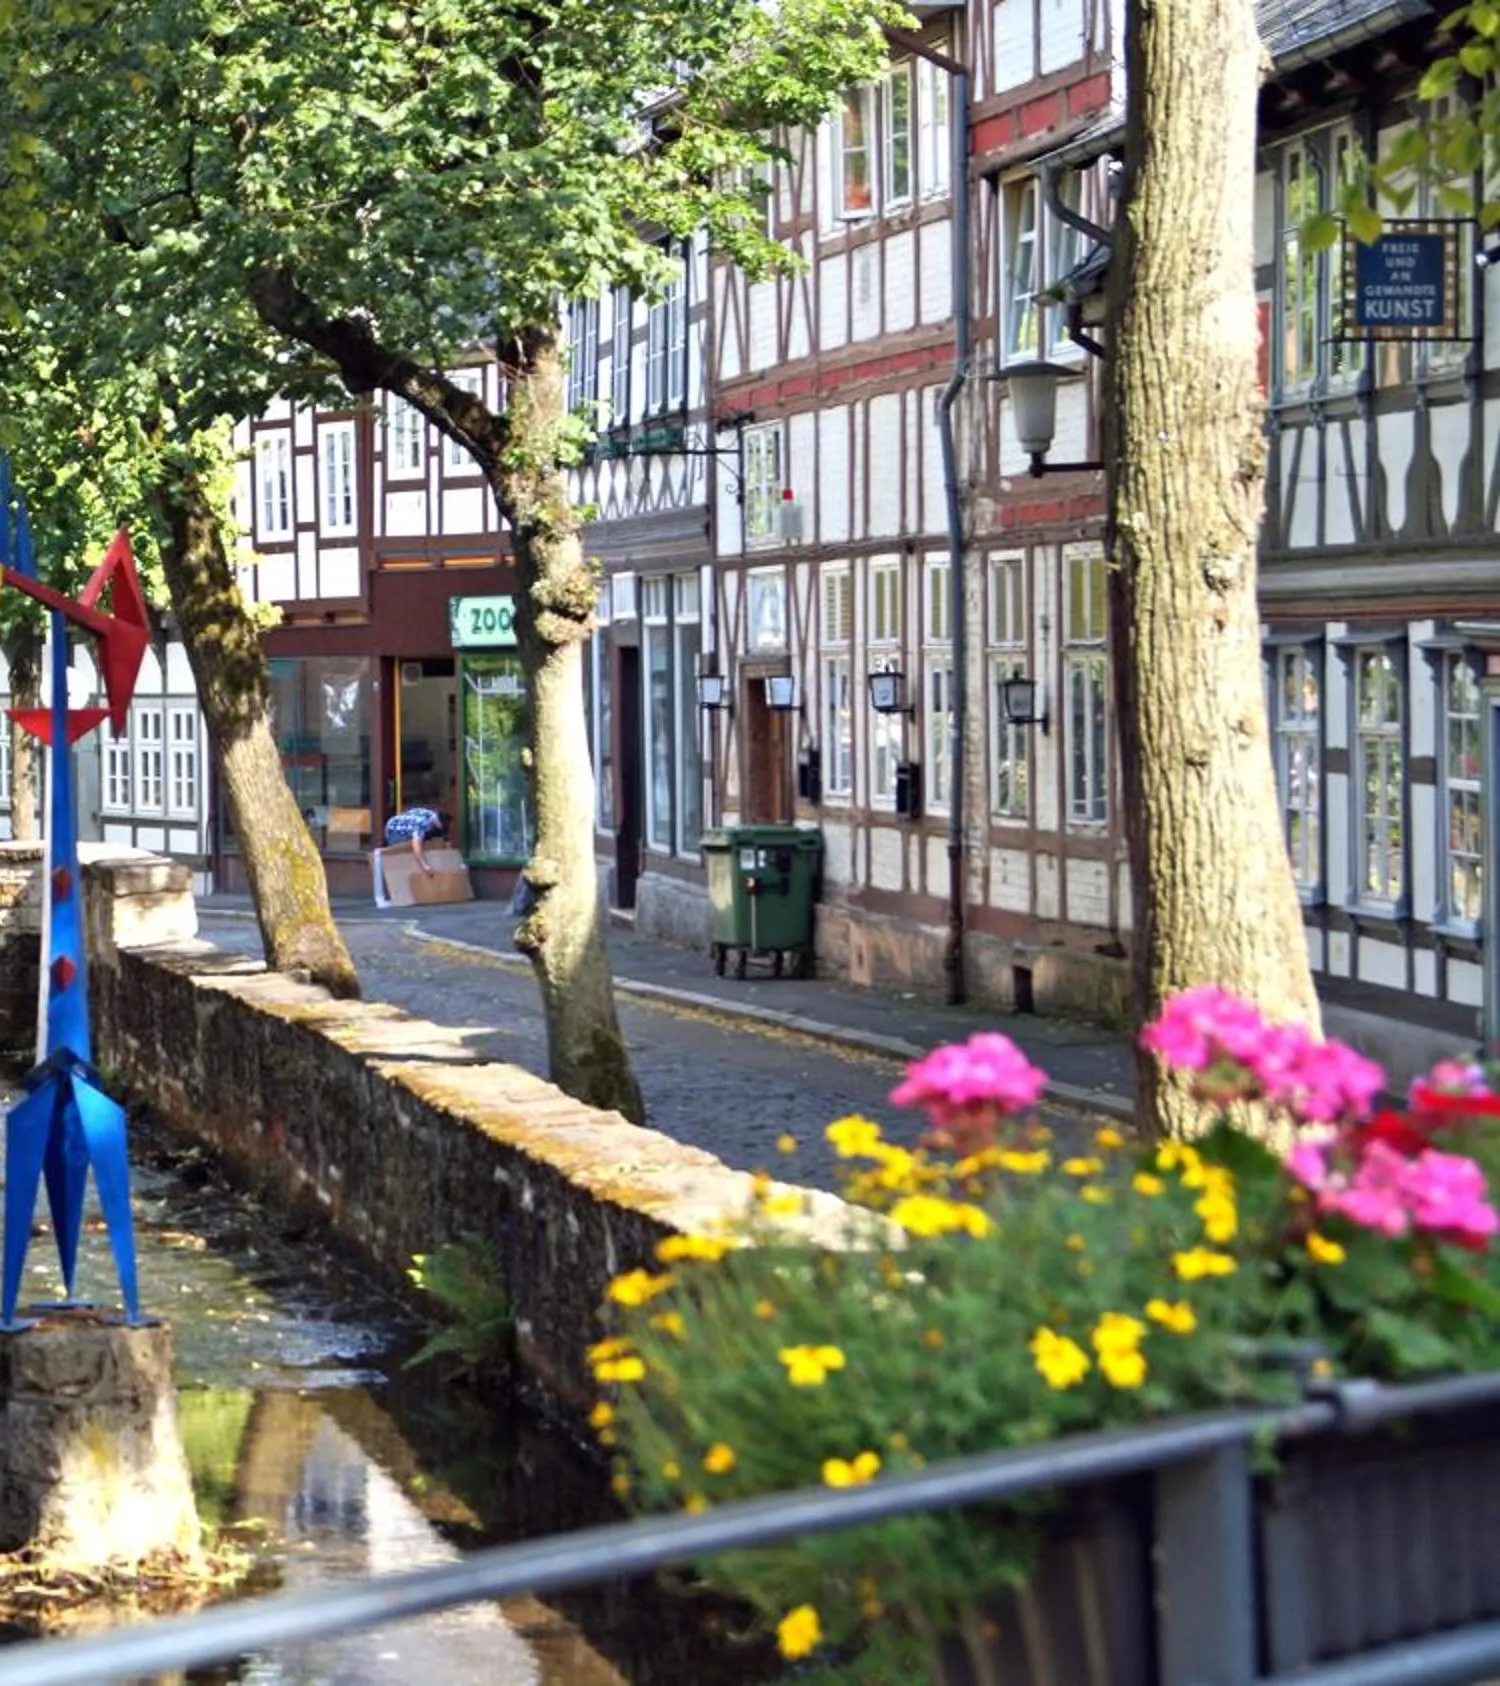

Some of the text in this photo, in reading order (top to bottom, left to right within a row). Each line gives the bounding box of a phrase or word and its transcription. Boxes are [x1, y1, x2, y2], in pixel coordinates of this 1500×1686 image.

[1385, 256, 1416, 268] UND
[1364, 299, 1436, 319] KUNST
[470, 608, 512, 634] ZOO
